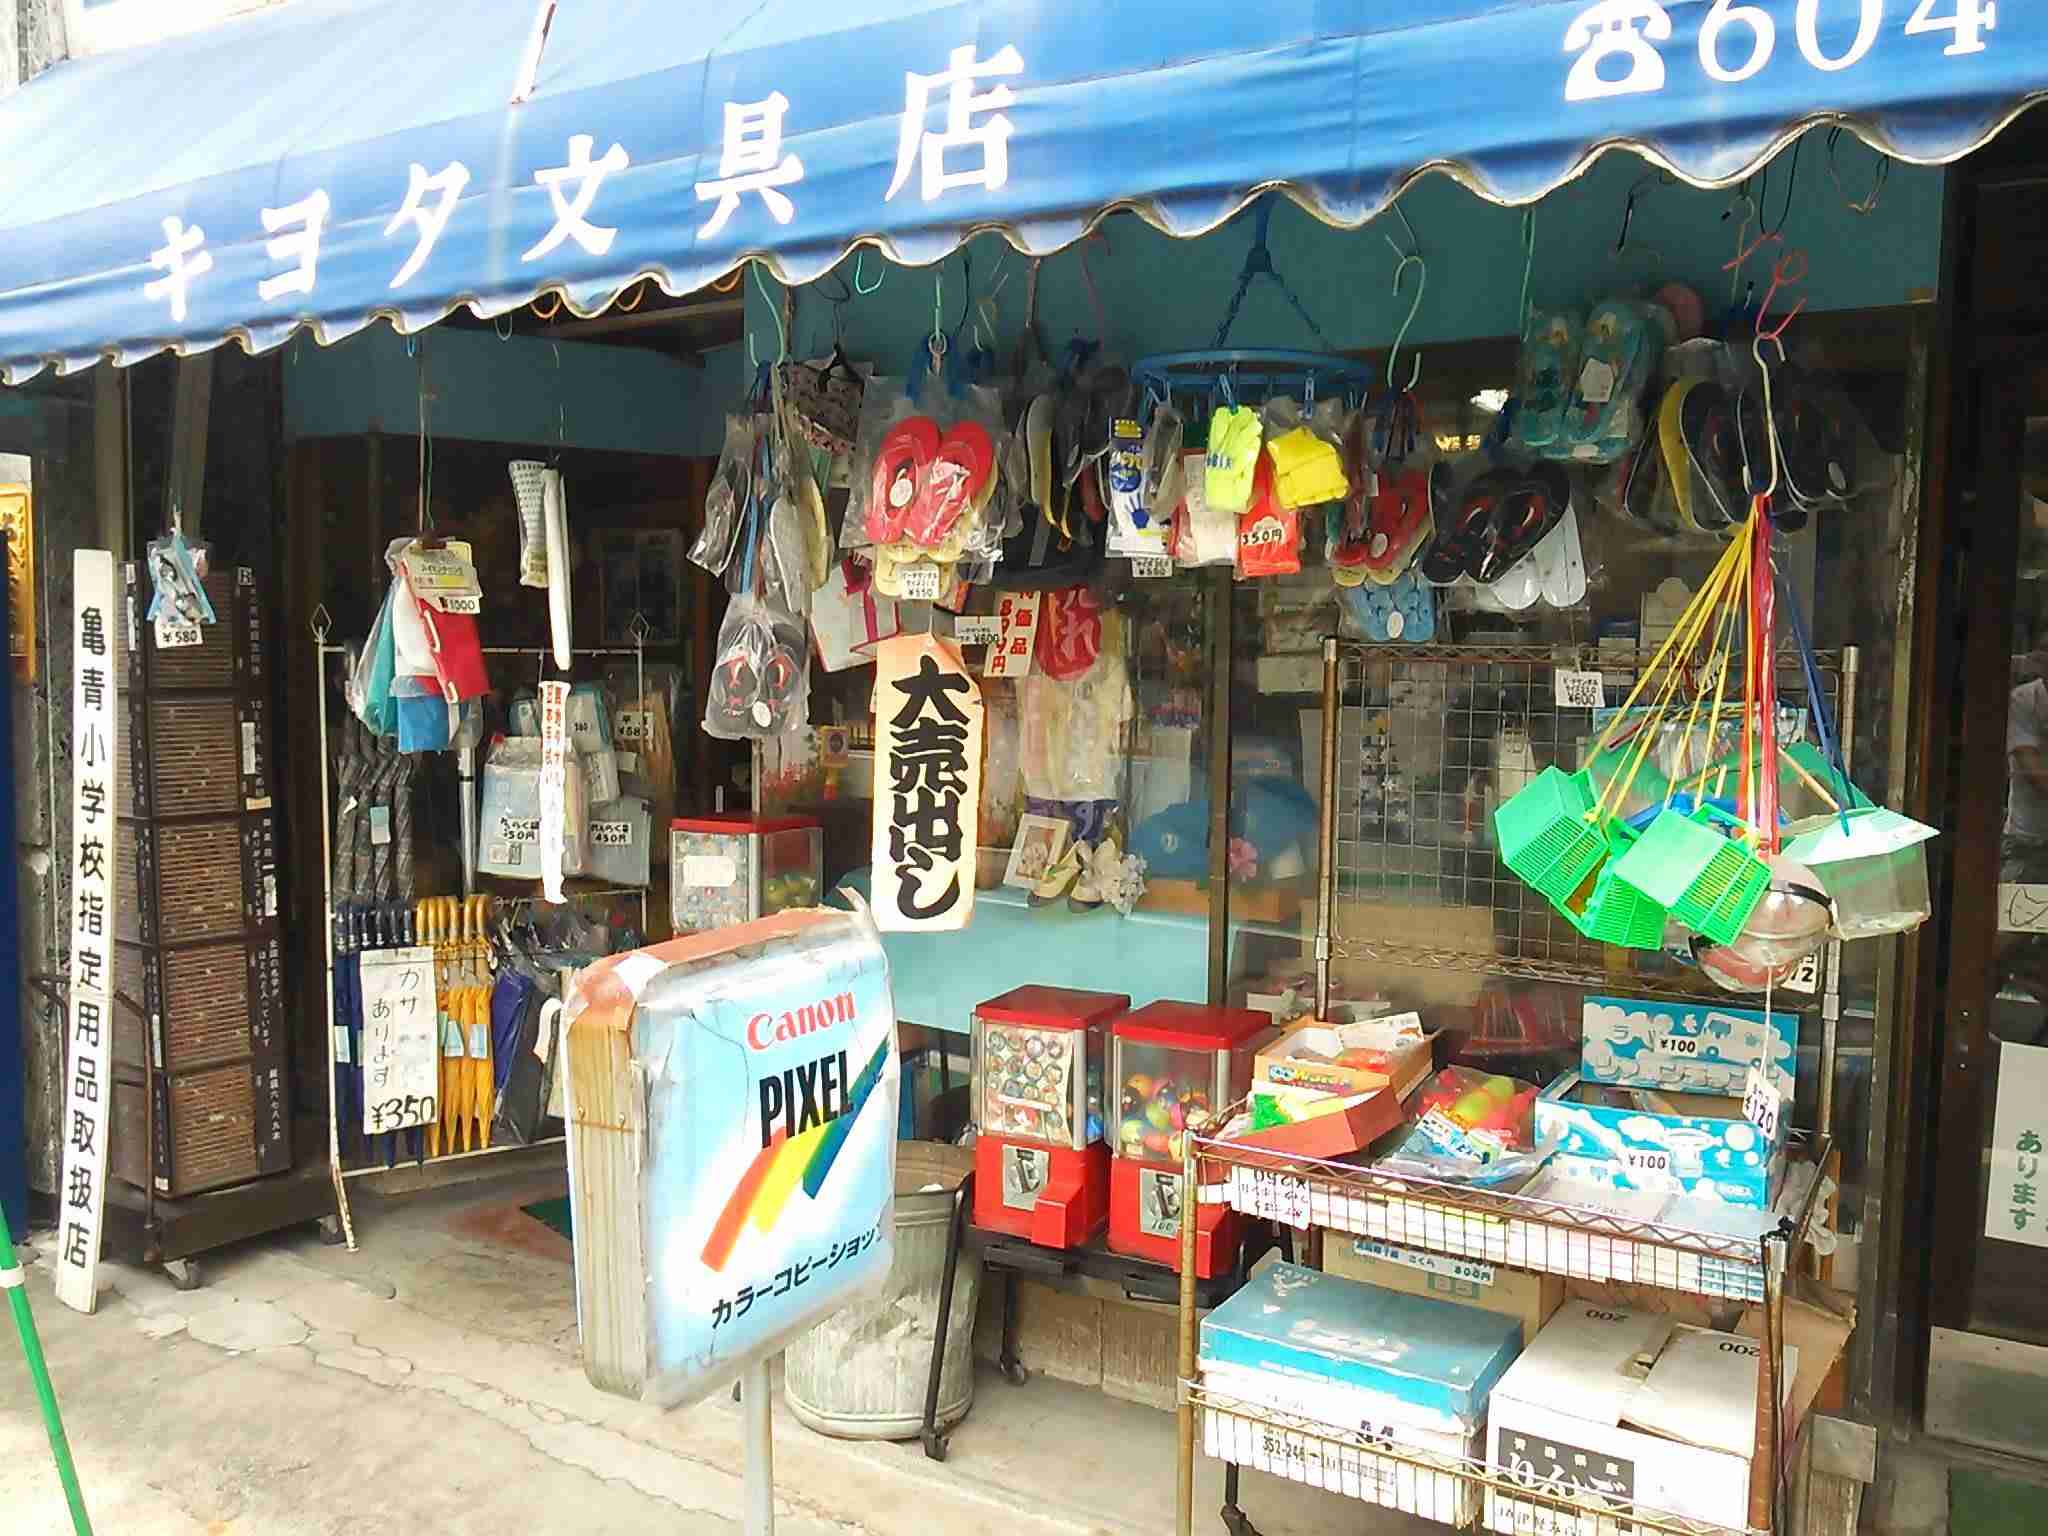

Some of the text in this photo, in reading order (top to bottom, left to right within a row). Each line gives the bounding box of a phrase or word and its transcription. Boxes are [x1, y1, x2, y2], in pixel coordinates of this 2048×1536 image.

[143, 43, 1025, 323] キヨタ文具店
[888, 653, 971, 920] 大売出し
[400, 967, 420, 1015] カサ
[746, 990, 857, 1052] Canon
[371, 997, 393, 1089] あります
[1660, 1038, 1697, 1054] ¥100
[371, 1094, 436, 1130] ¥350
[758, 1050, 855, 1150] PIXEL
[1628, 1153, 1667, 1170] ¥100
[2008, 1129, 2042, 1231] あります
[711, 1223, 882, 1330] カラーコピーショッ
